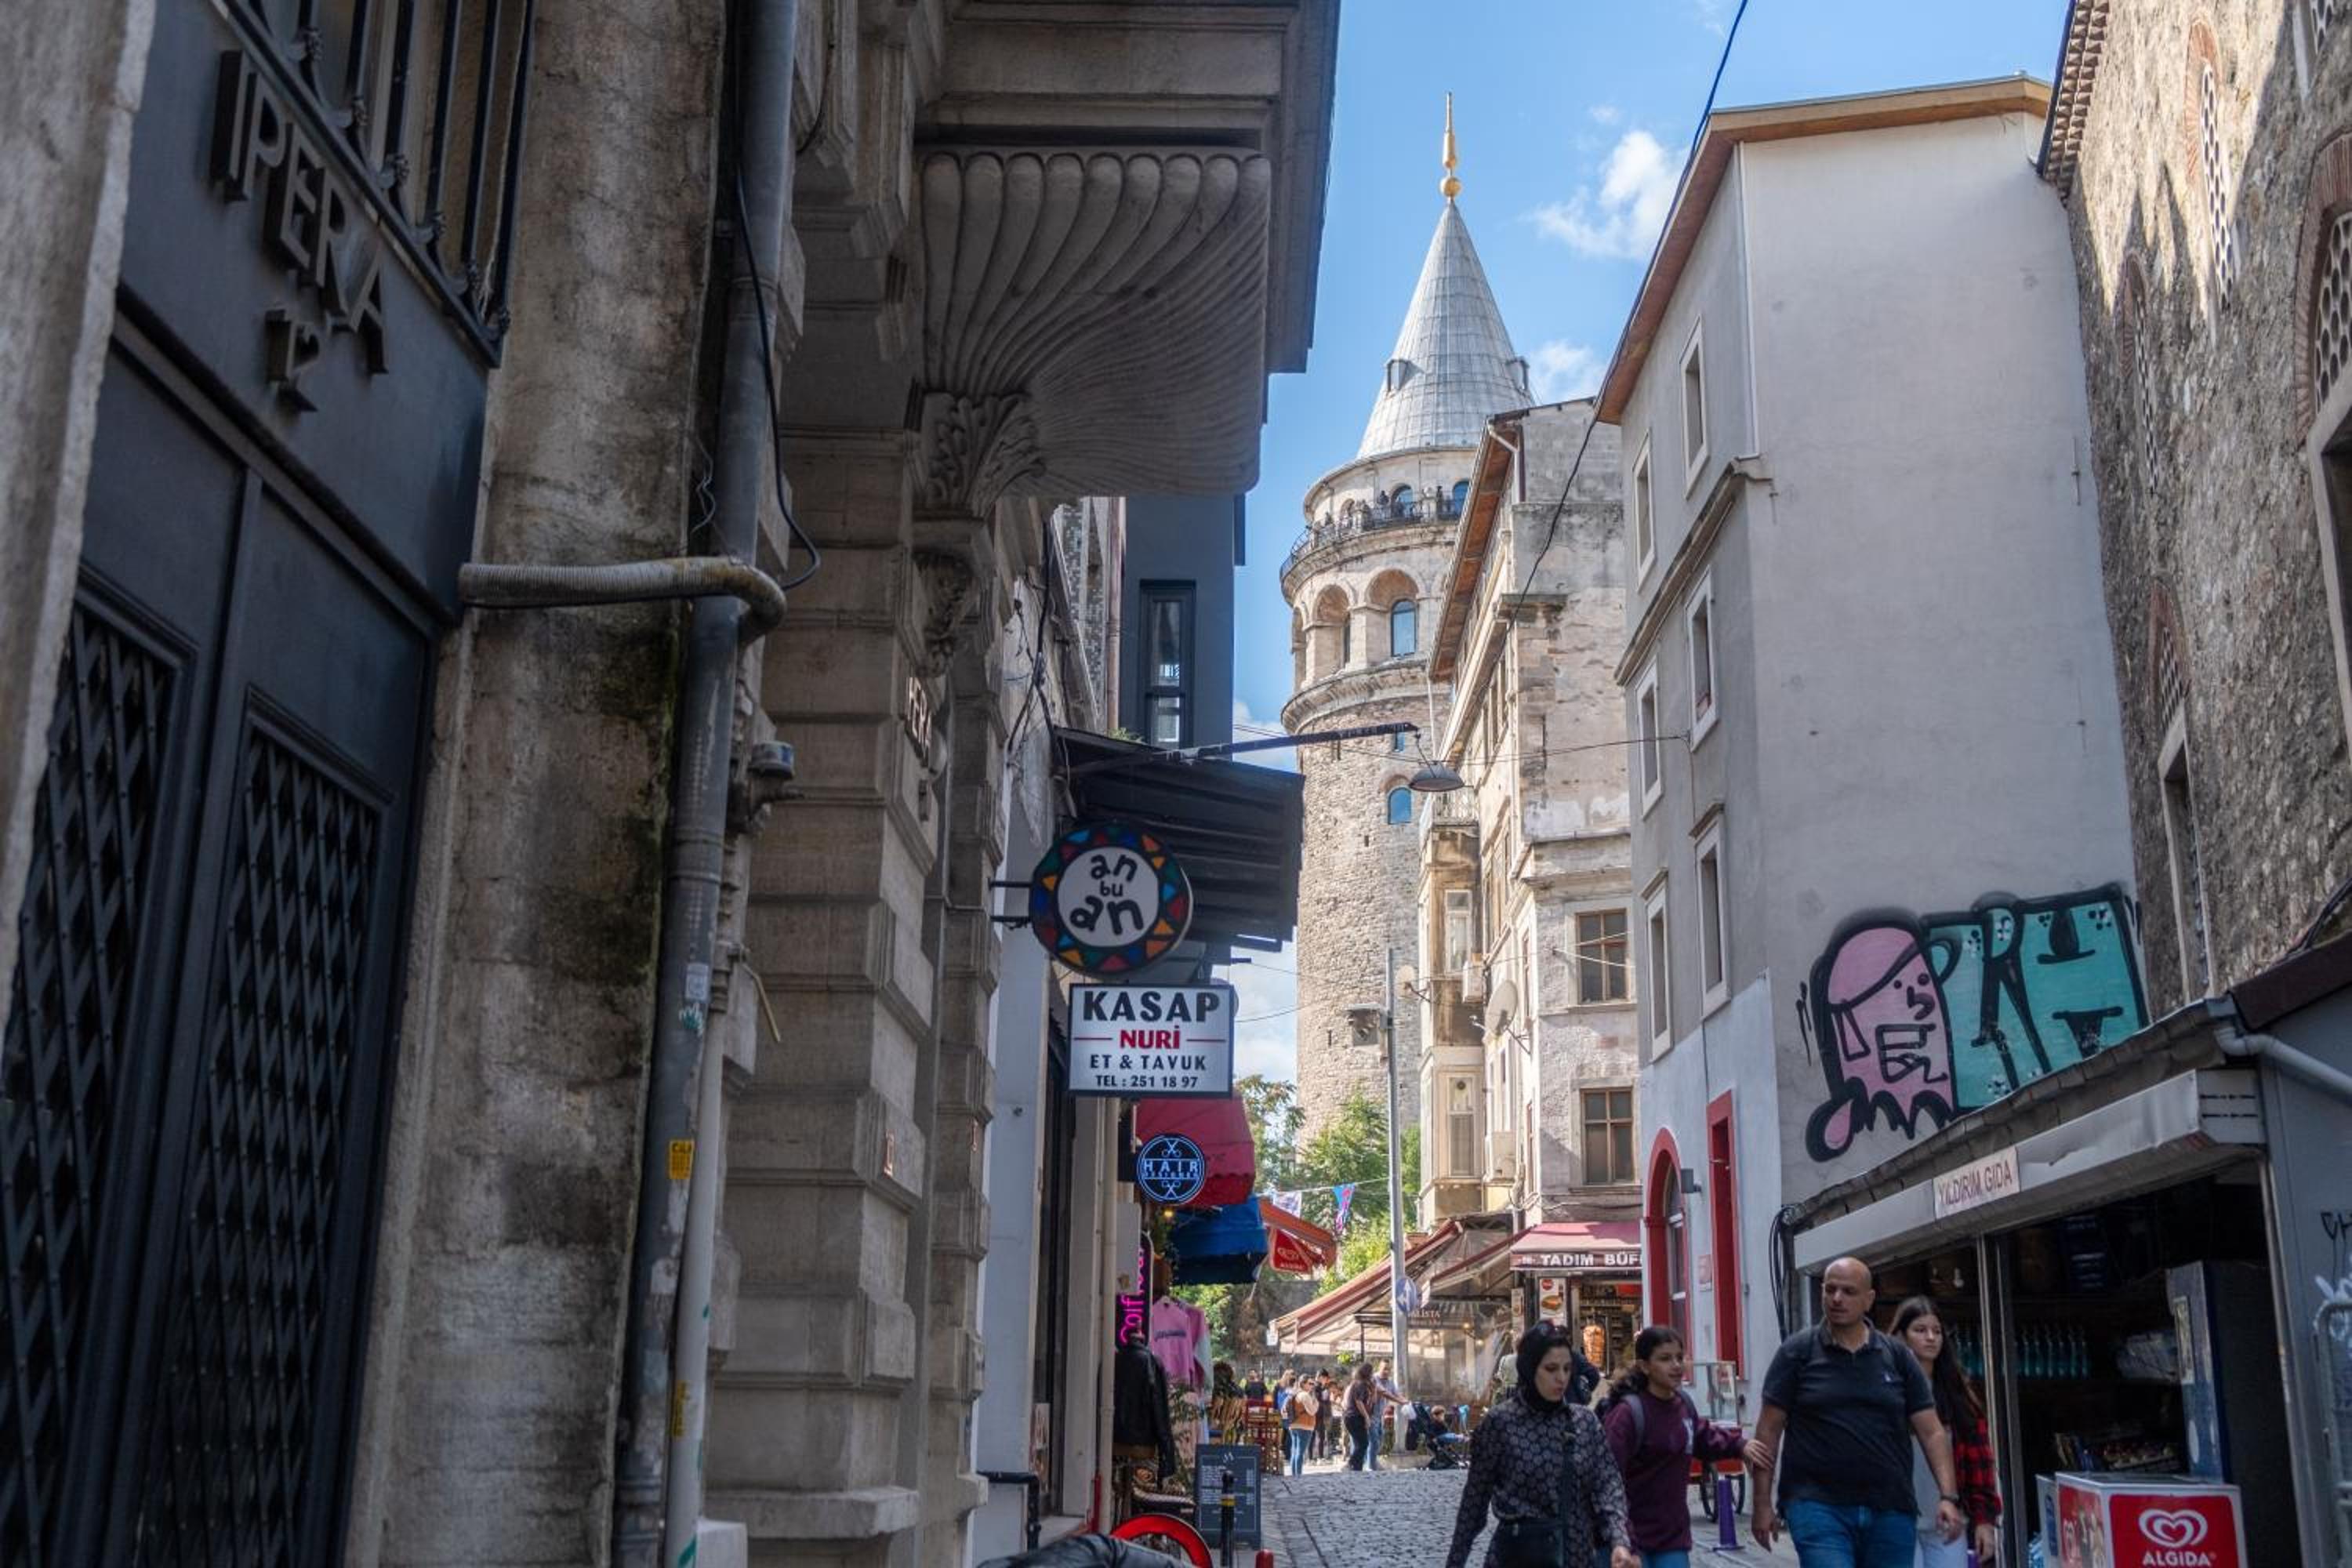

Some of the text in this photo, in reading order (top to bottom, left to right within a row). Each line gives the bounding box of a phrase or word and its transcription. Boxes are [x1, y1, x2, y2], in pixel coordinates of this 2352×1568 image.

[1091, 855, 1138, 882] an
[1099, 881, 1123, 897] bu
[1083, 991, 1220, 1023] KASAP
[1120, 1025, 1180, 1049] NURİ
[1091, 1054, 1206, 1071] ET & TAVUK
[1131, 1075, 1155, 1087] 251
[1162, 1076, 1177, 1088] 18
[1181, 1076, 1198, 1088] 97
[1144, 1160, 1198, 1172] HAIR
[1984, 1160, 2013, 1192] GIDA
[1541, 1254, 1594, 1266] TADIM
[1604, 1252, 1642, 1266] BÜF
[2142, 1550, 2211, 1566] ALGIDA
